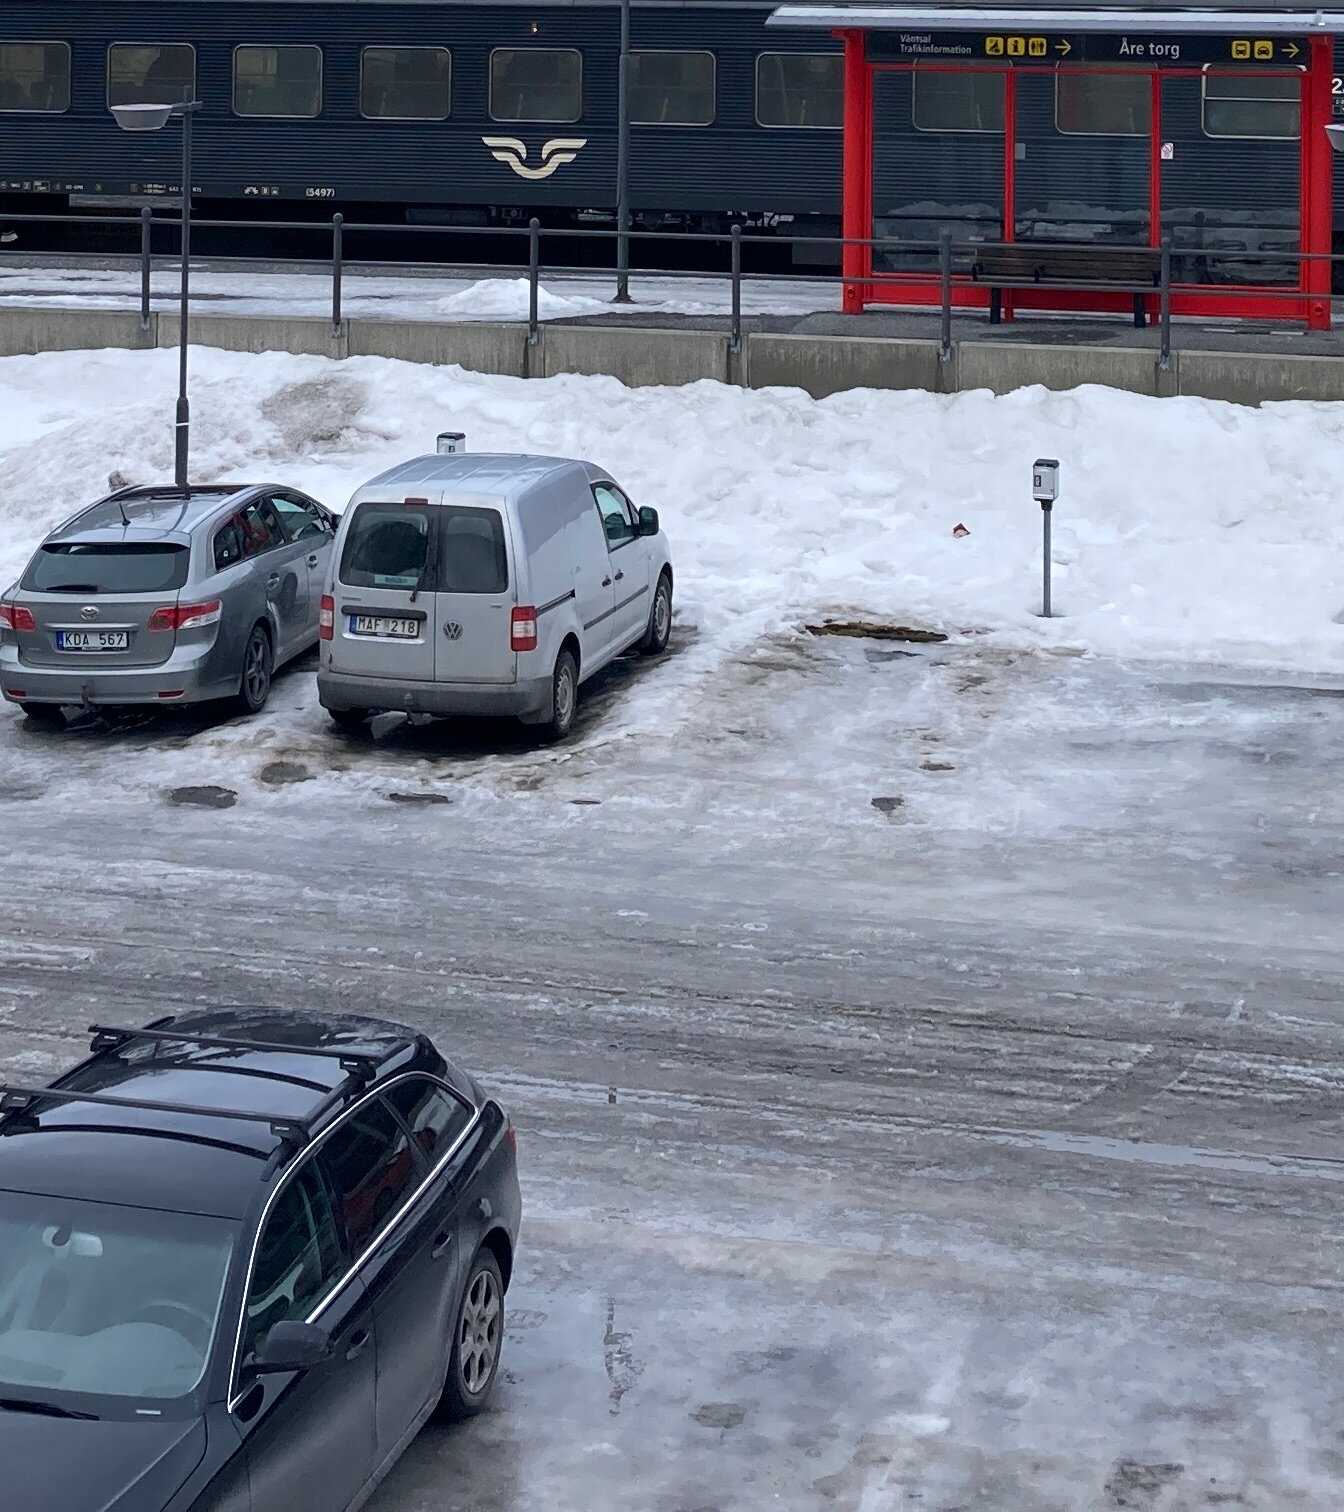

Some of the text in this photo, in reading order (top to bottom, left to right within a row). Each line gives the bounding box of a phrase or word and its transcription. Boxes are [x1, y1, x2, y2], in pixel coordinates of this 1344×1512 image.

[1119, 36, 1181, 60] Åre torg
[1331, 77, 1343, 95] 2
[358, 616, 416, 634] MAF 218
[99, 633, 124, 646] 567
